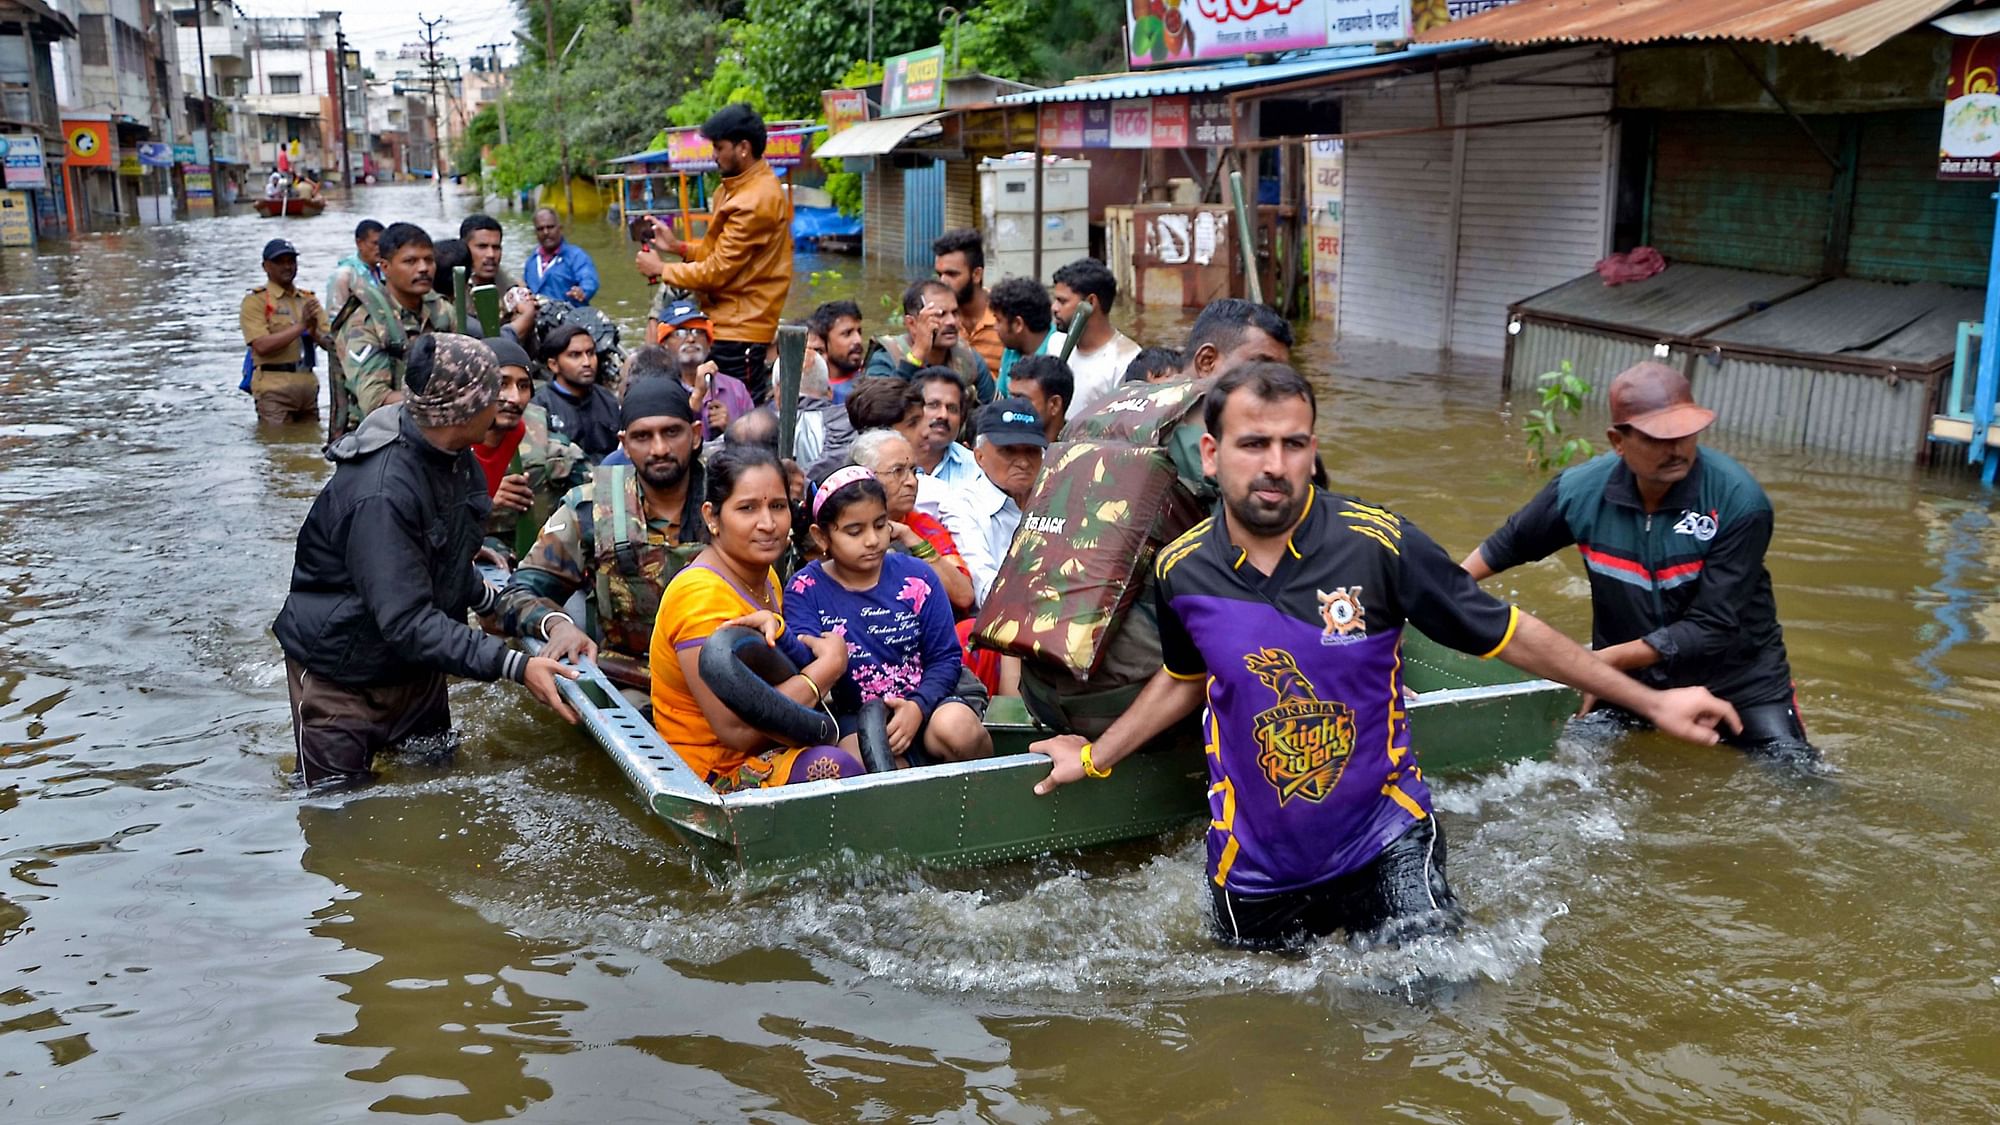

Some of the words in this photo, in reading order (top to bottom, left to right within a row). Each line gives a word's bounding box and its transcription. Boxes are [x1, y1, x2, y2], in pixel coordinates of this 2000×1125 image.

[1037, 516, 1066, 535] BACK
[860, 606, 890, 617] Fashion
[866, 624, 897, 635] Fashion
[1257, 715, 1351, 755] Knight
[1261, 729, 1351, 782] Riders
